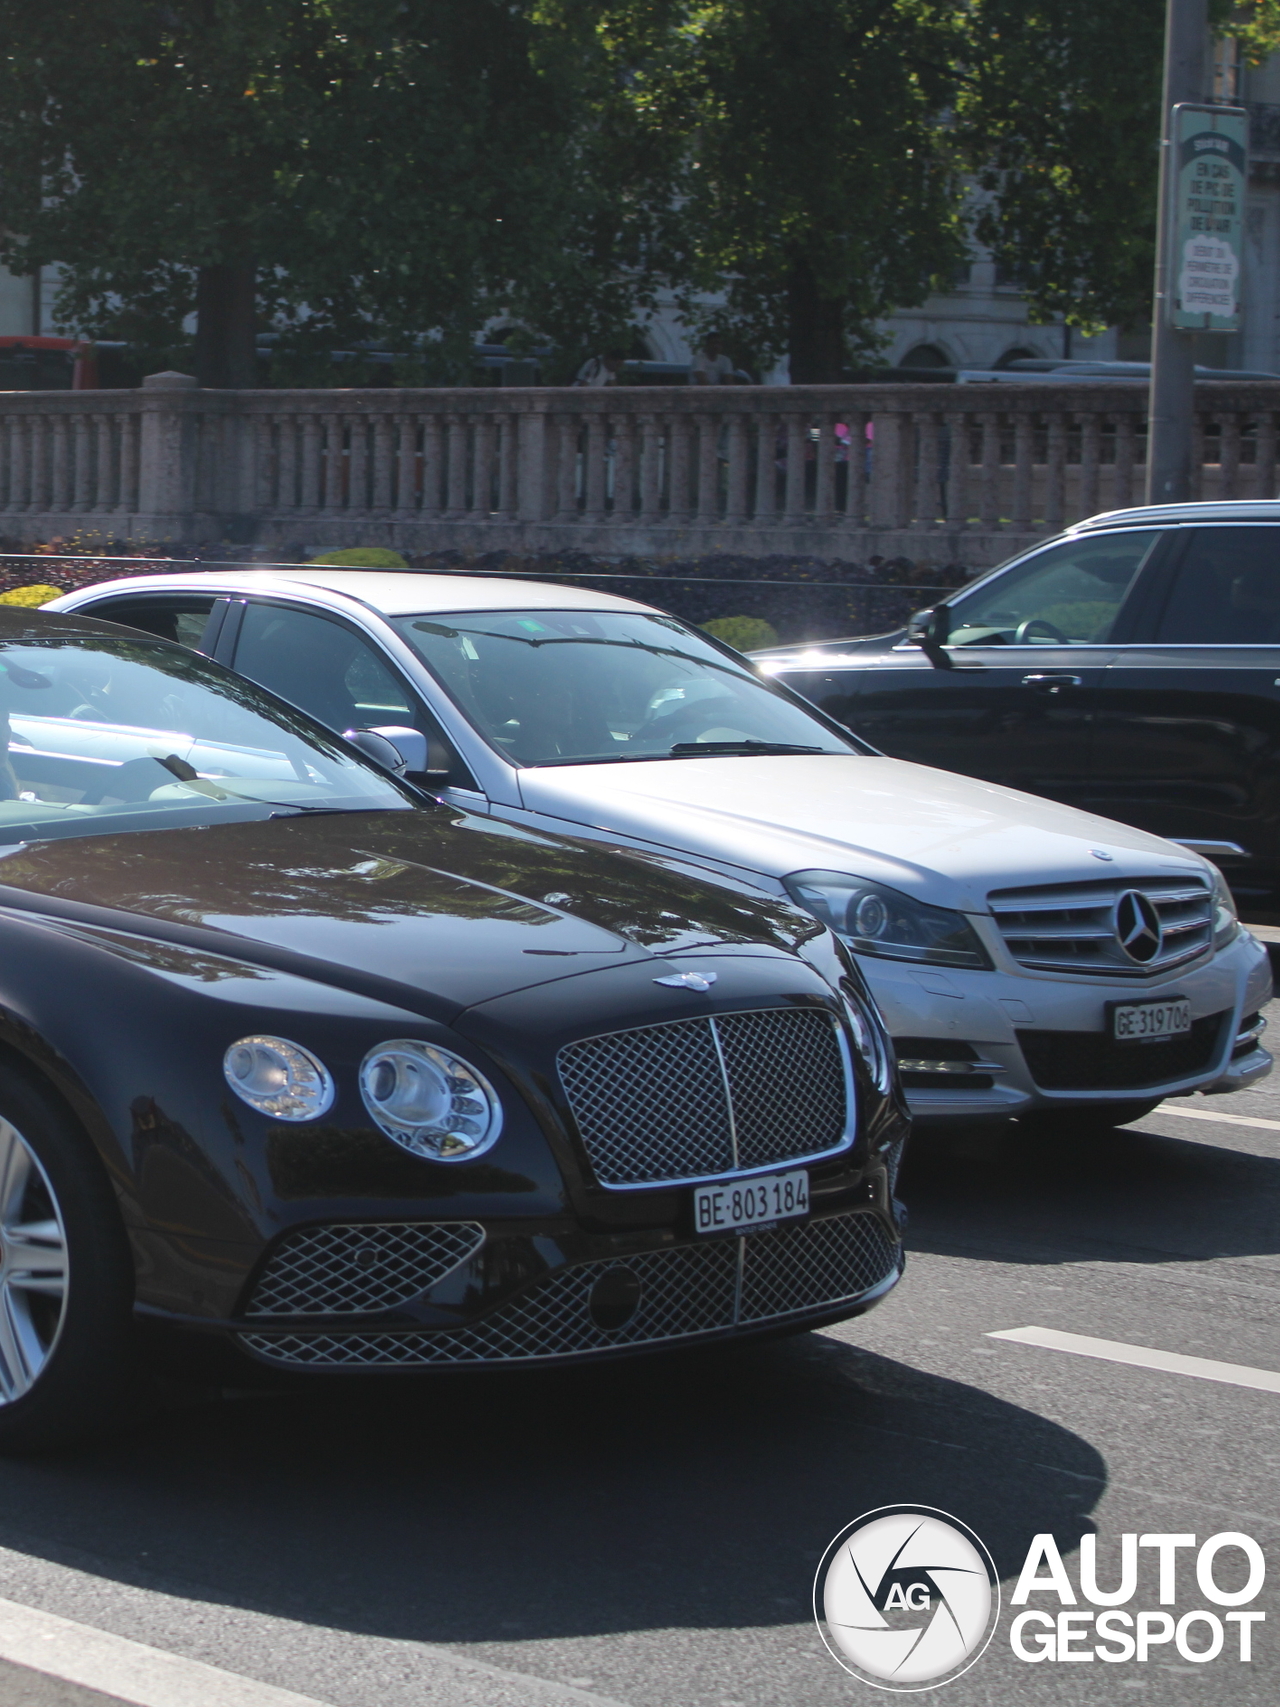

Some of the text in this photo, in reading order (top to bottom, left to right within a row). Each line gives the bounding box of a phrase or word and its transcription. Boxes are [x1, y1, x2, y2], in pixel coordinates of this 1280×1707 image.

[1196, 162, 1230, 179] EN CAS
[1190, 180, 1203, 195] DE
[1222, 183, 1236, 198] DE
[1186, 198, 1236, 216] POLLUTION
[1190, 216, 1203, 231] DE
